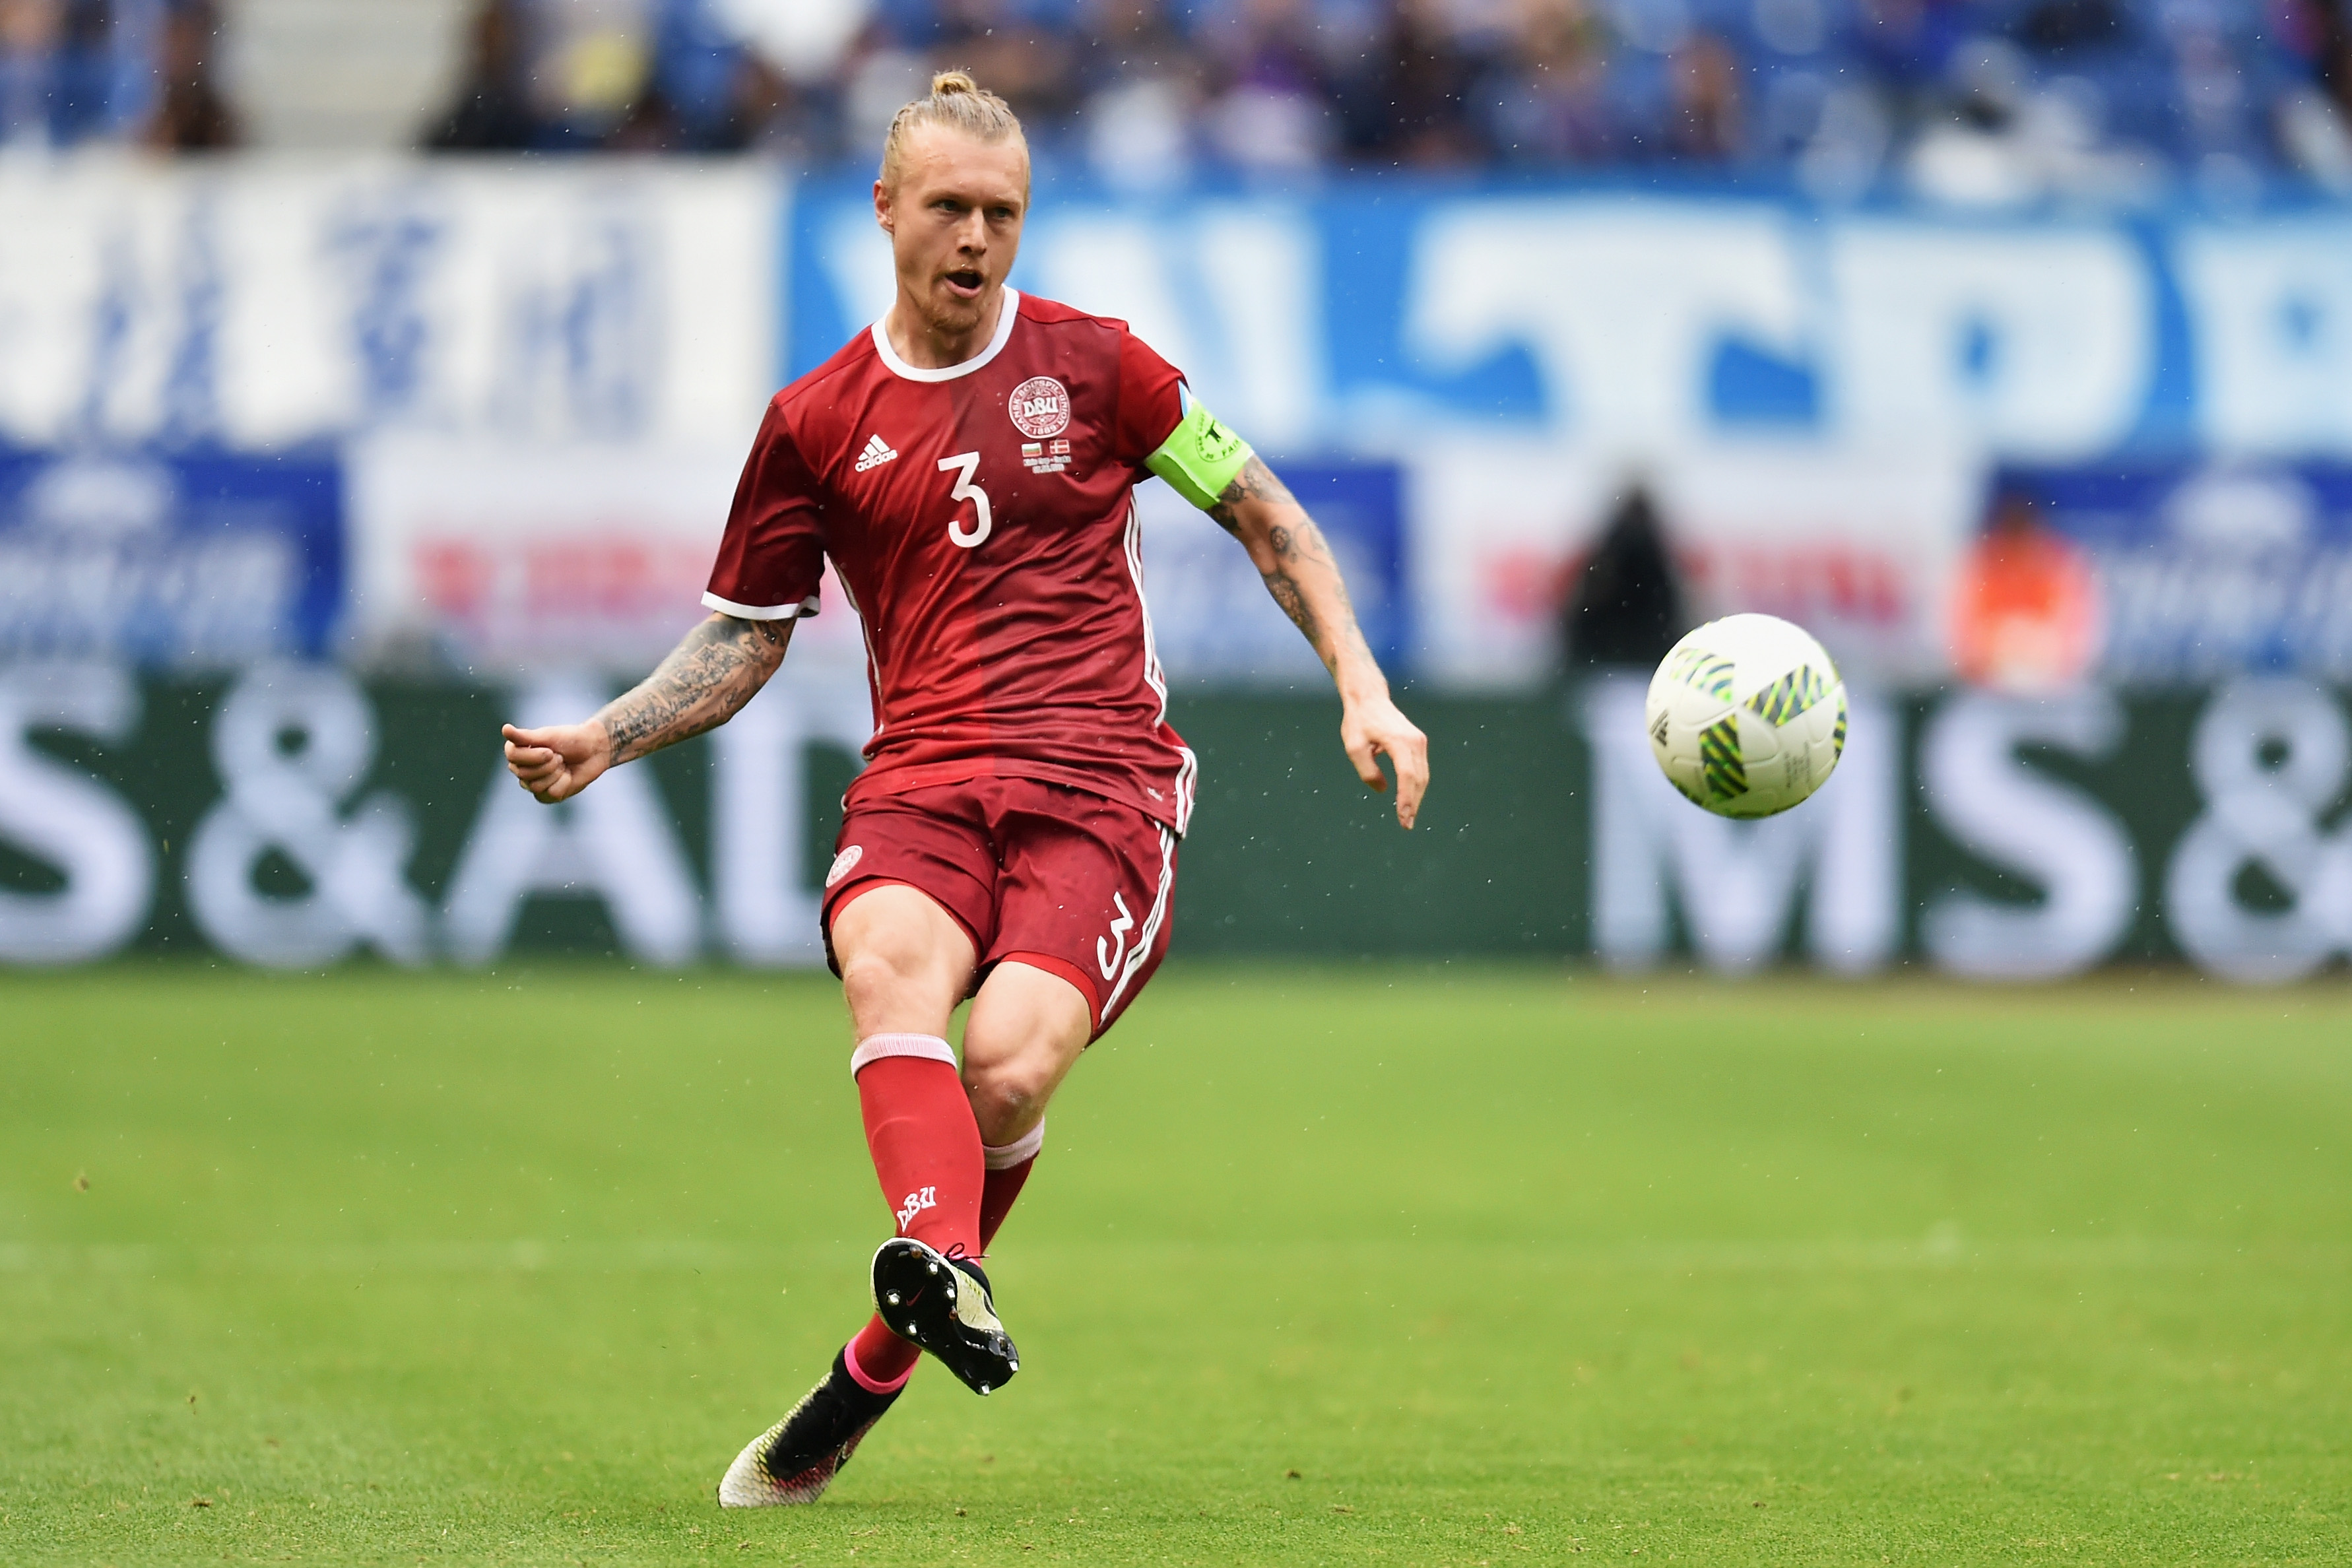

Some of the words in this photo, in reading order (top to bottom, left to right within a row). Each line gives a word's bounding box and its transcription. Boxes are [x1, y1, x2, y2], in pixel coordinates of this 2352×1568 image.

[1023, 397, 1059, 418] DBU
[1058, 394, 1068, 426] UNION
[855, 449, 898, 473] adidas
[937, 451, 992, 548] 3
[1097, 891, 1134, 981] 3
[896, 1186, 936, 1233] DBU
